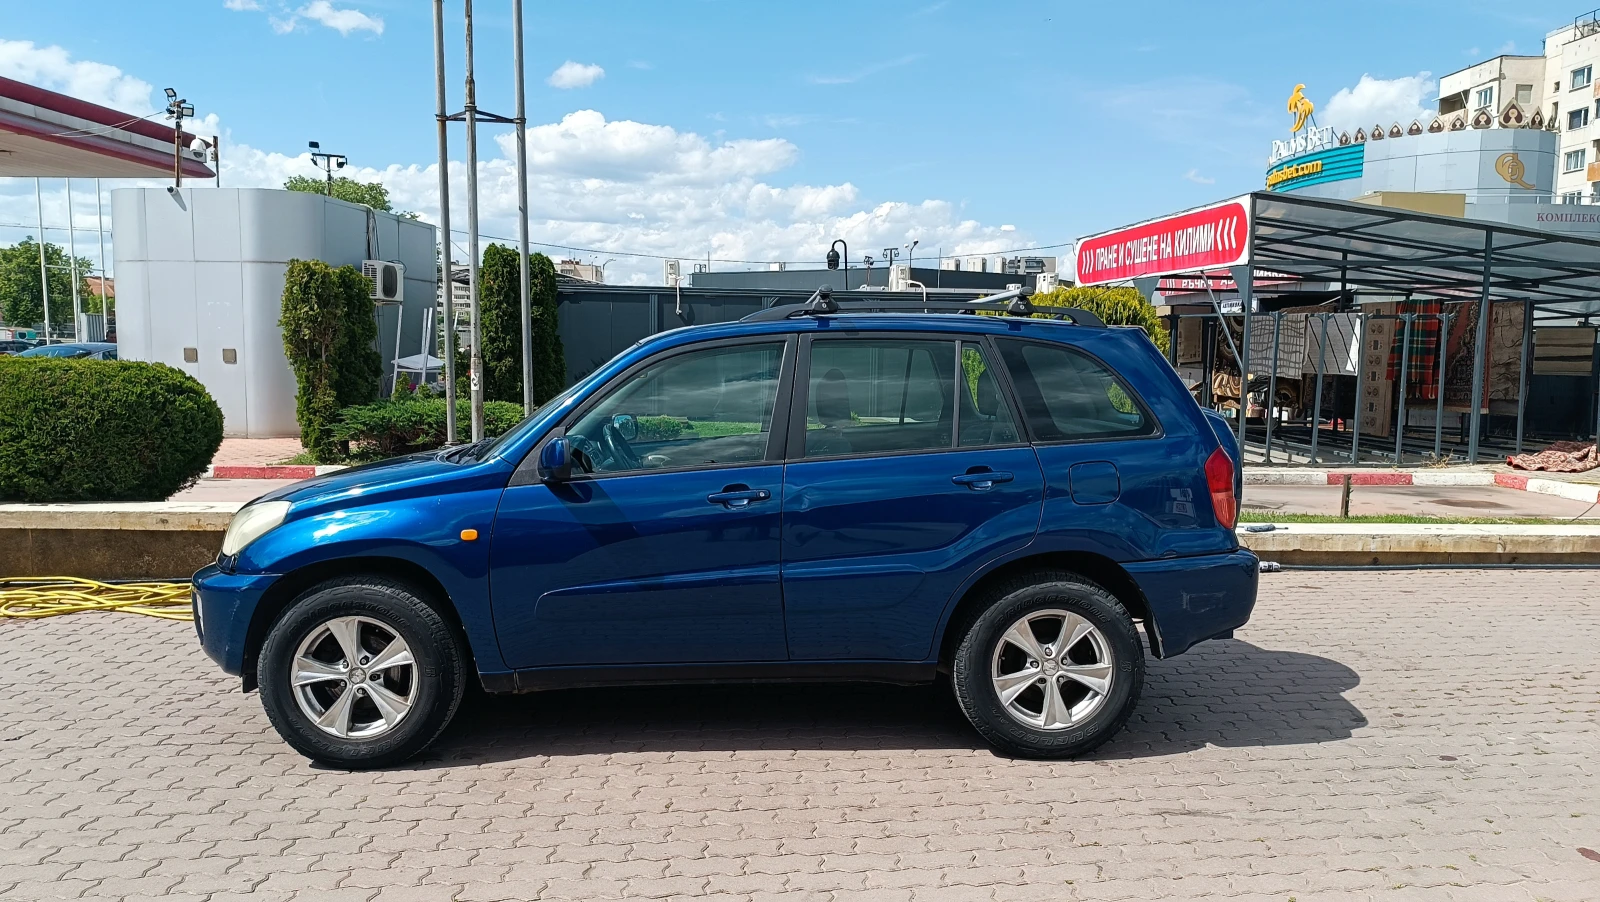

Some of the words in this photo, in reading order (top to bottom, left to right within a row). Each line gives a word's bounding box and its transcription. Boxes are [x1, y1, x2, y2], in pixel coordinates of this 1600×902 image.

[1307, 126, 1333, 151] BET
[1096, 244, 1118, 271] ПРАНЕ
[1118, 242, 1125, 267] И
[1125, 235, 1159, 266] СУШЕНЕ
[1160, 231, 1172, 260] НА
[1174, 222, 1215, 257] КИЛИМИ
